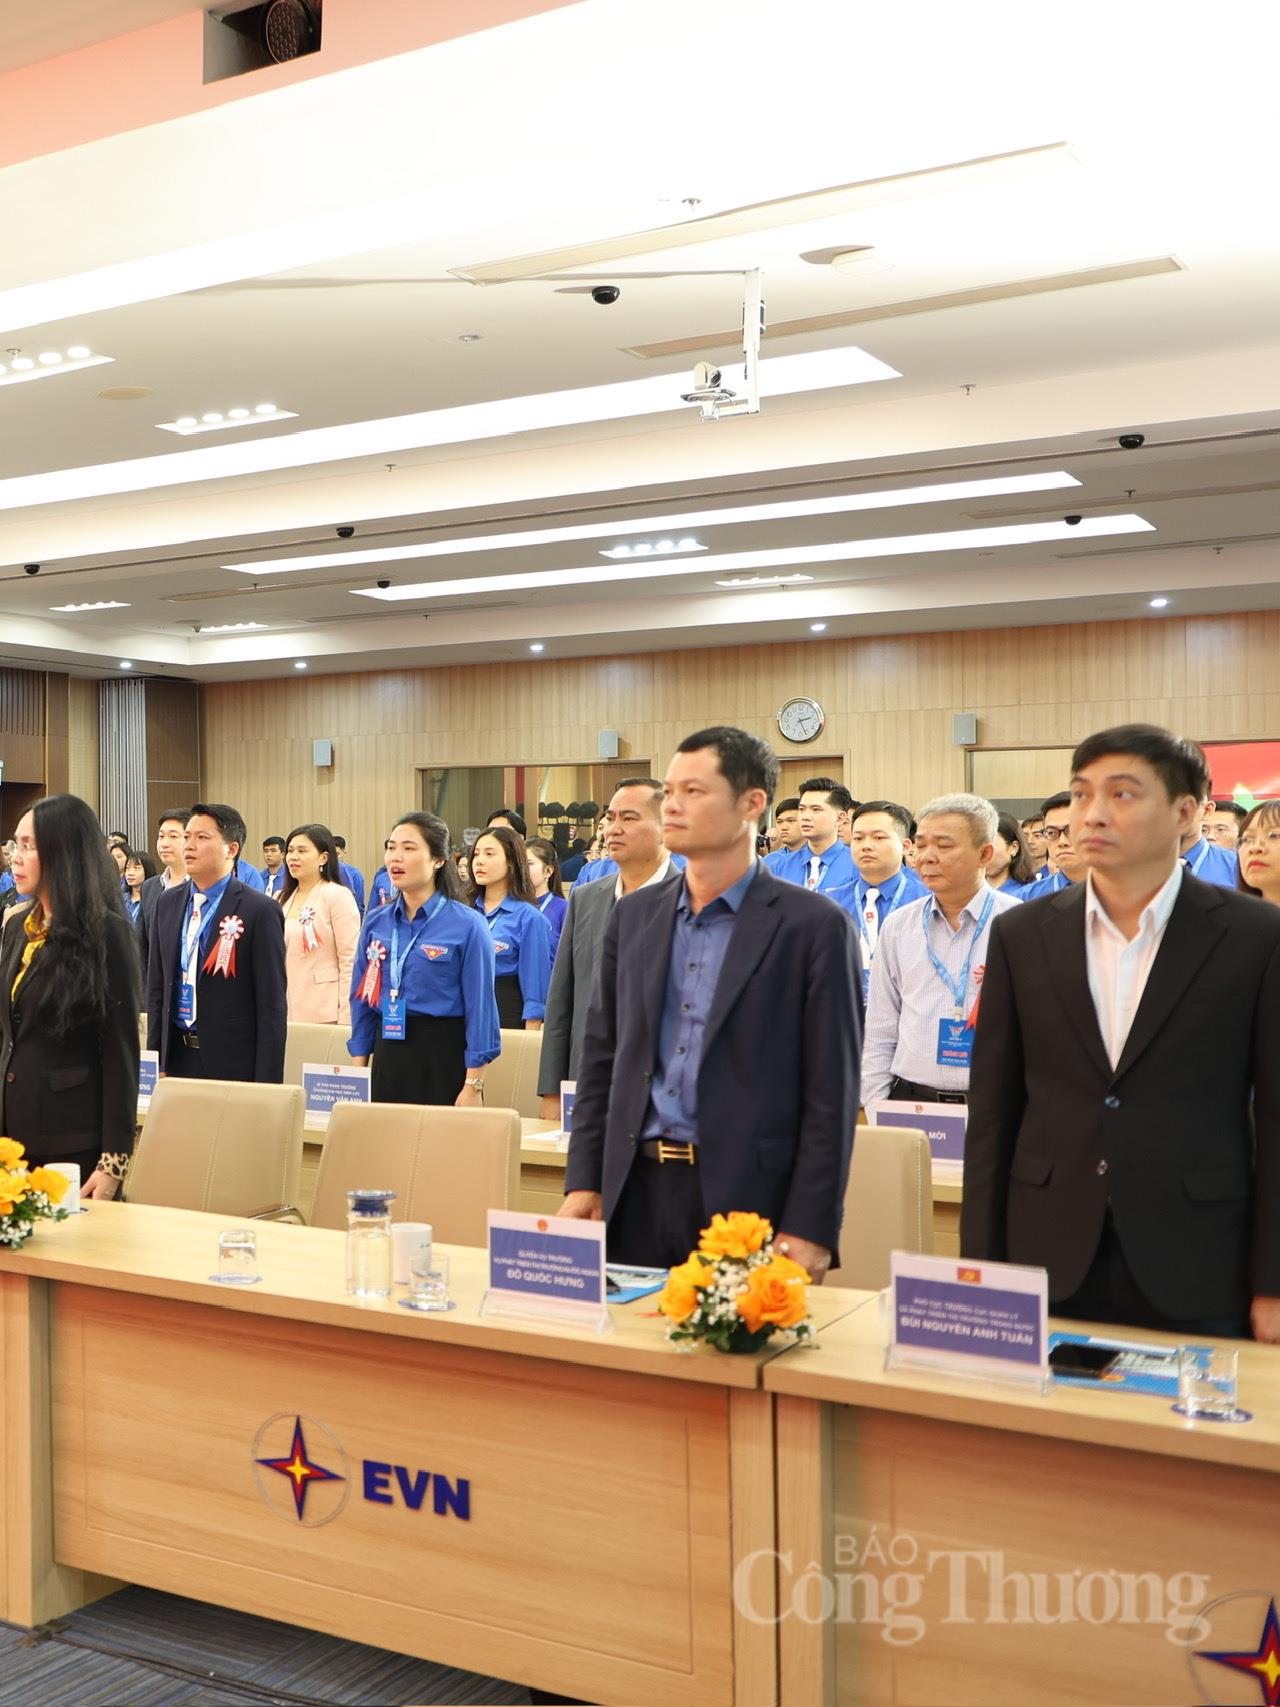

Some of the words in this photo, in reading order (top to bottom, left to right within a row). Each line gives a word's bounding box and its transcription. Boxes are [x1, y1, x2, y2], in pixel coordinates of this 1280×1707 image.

[555, 1276, 584, 1288] HƯNG
[901, 1315, 920, 1328] BÙI
[973, 1327, 998, 1340] ANH
[363, 1459, 471, 1520] EVN
